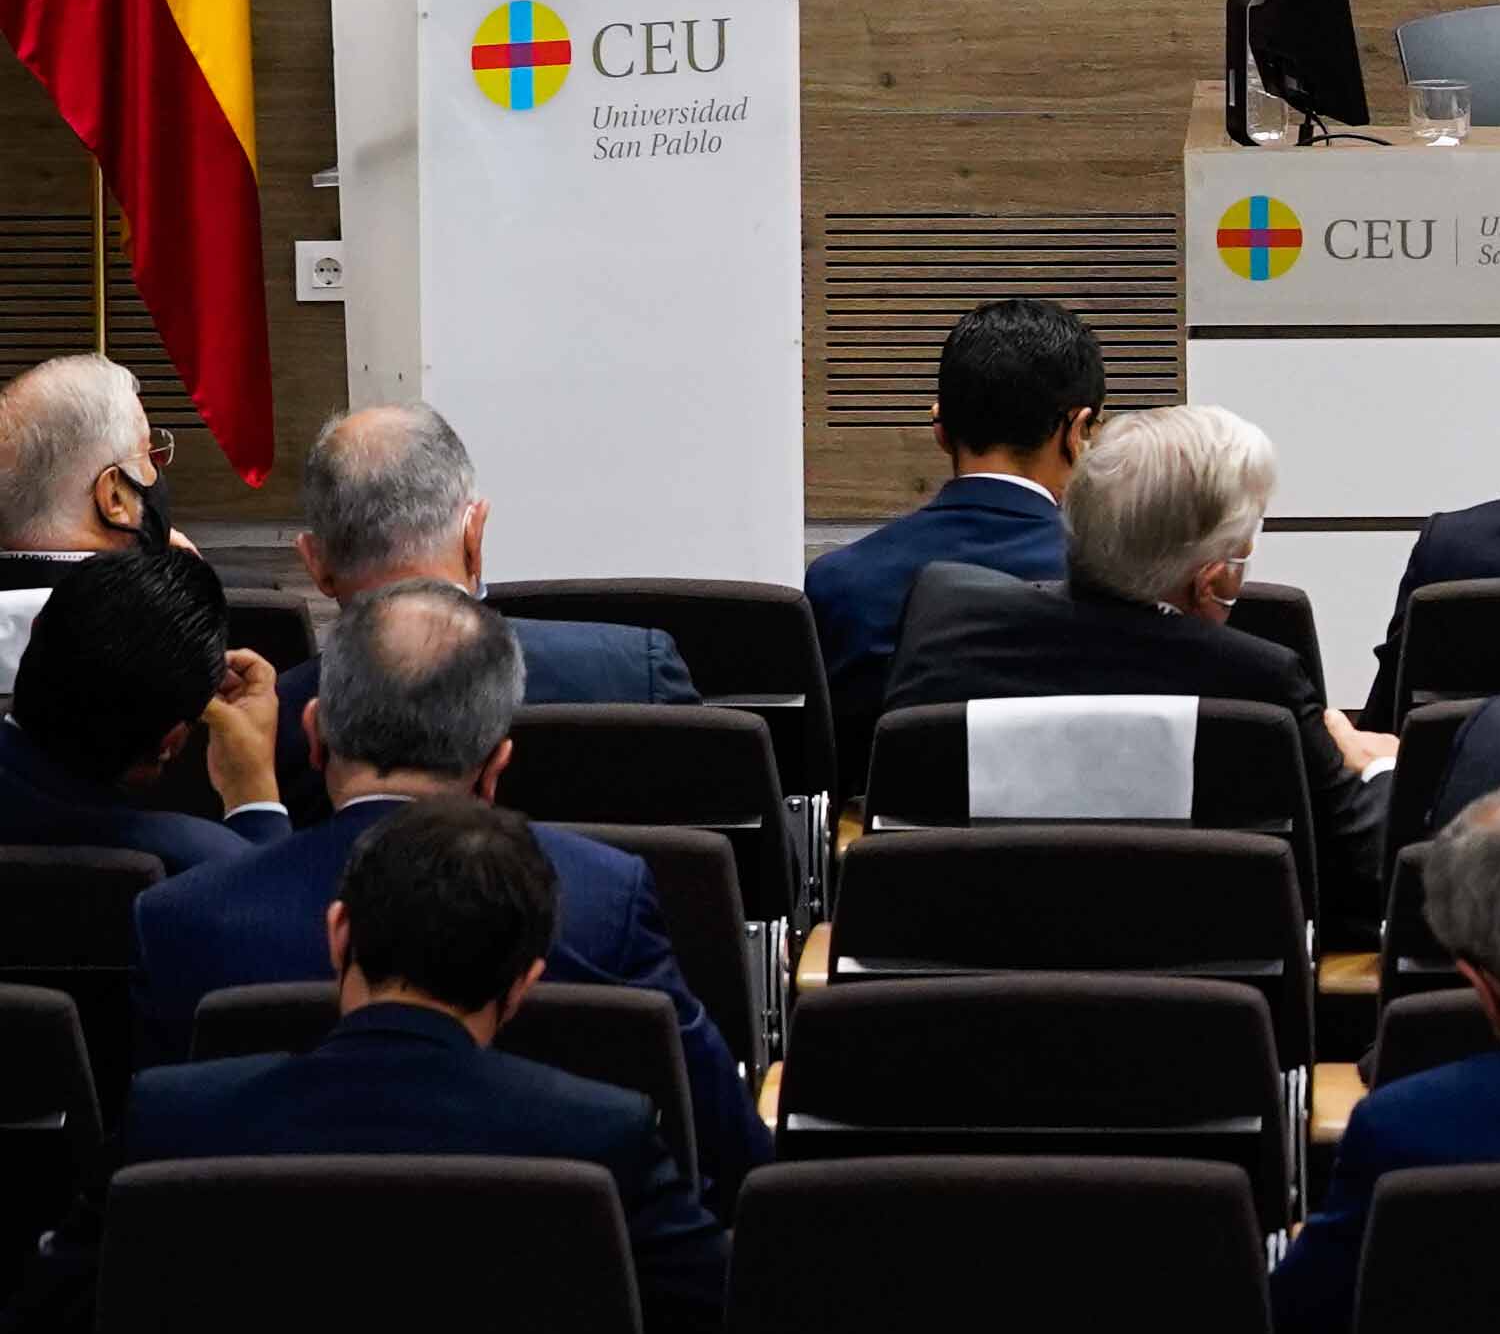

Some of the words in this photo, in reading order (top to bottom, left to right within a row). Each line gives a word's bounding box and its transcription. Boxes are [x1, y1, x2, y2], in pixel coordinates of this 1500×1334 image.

[592, 17, 732, 78] CEU
[592, 96, 749, 130] Universidad
[593, 136, 642, 161] San
[650, 129, 723, 156] Pablo
[1324, 220, 1437, 259] CEU
